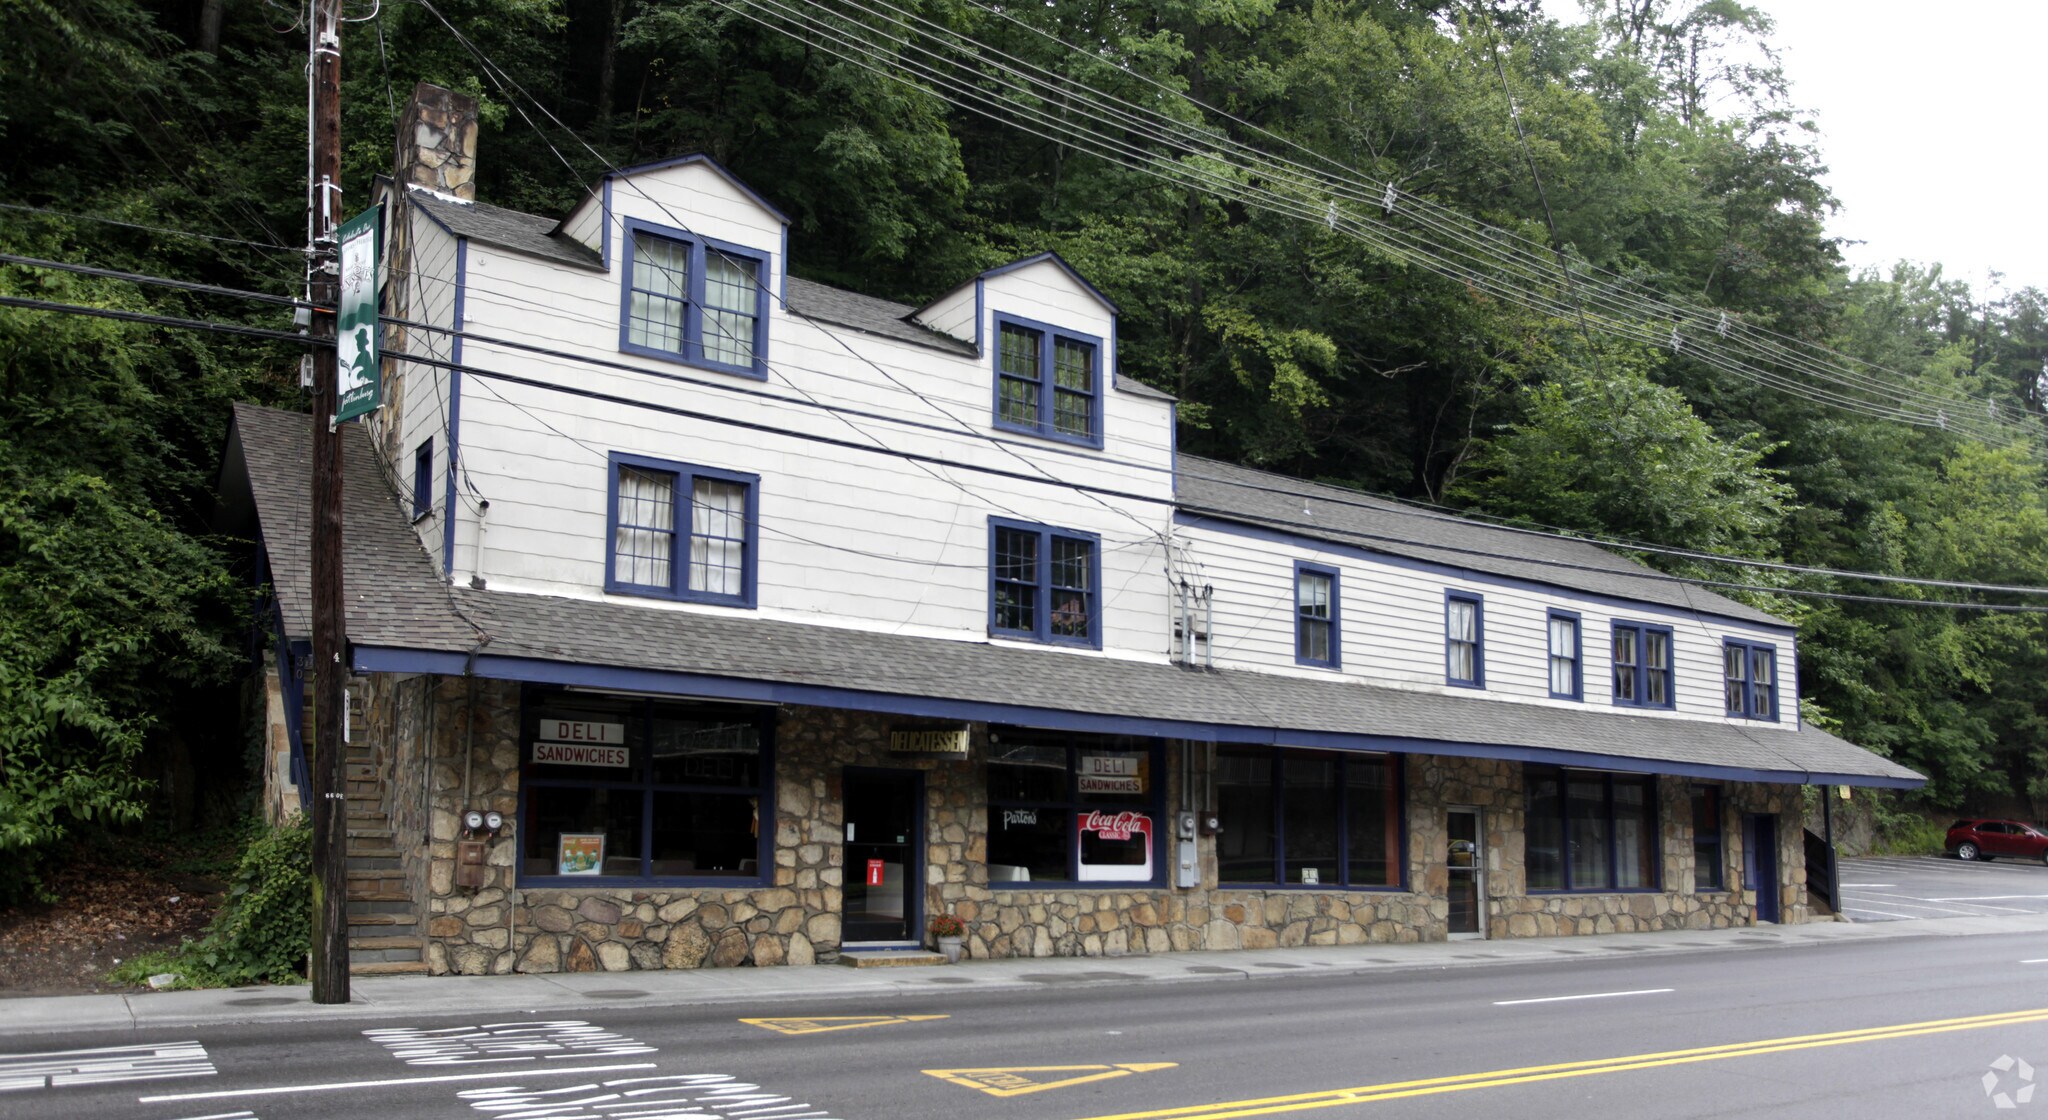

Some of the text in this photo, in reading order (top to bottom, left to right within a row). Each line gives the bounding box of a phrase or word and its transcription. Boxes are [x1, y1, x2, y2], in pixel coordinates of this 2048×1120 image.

[333, 652, 340, 663] 4
[558, 722, 605, 741] DELI
[890, 730, 968, 753] DELICATESSEN
[537, 745, 625, 765] SANDWICHES
[1094, 758, 1126, 773] DELI
[1080, 779, 1140, 791] SANDWICHES
[1086, 810, 1142, 832] Coca-Cola
